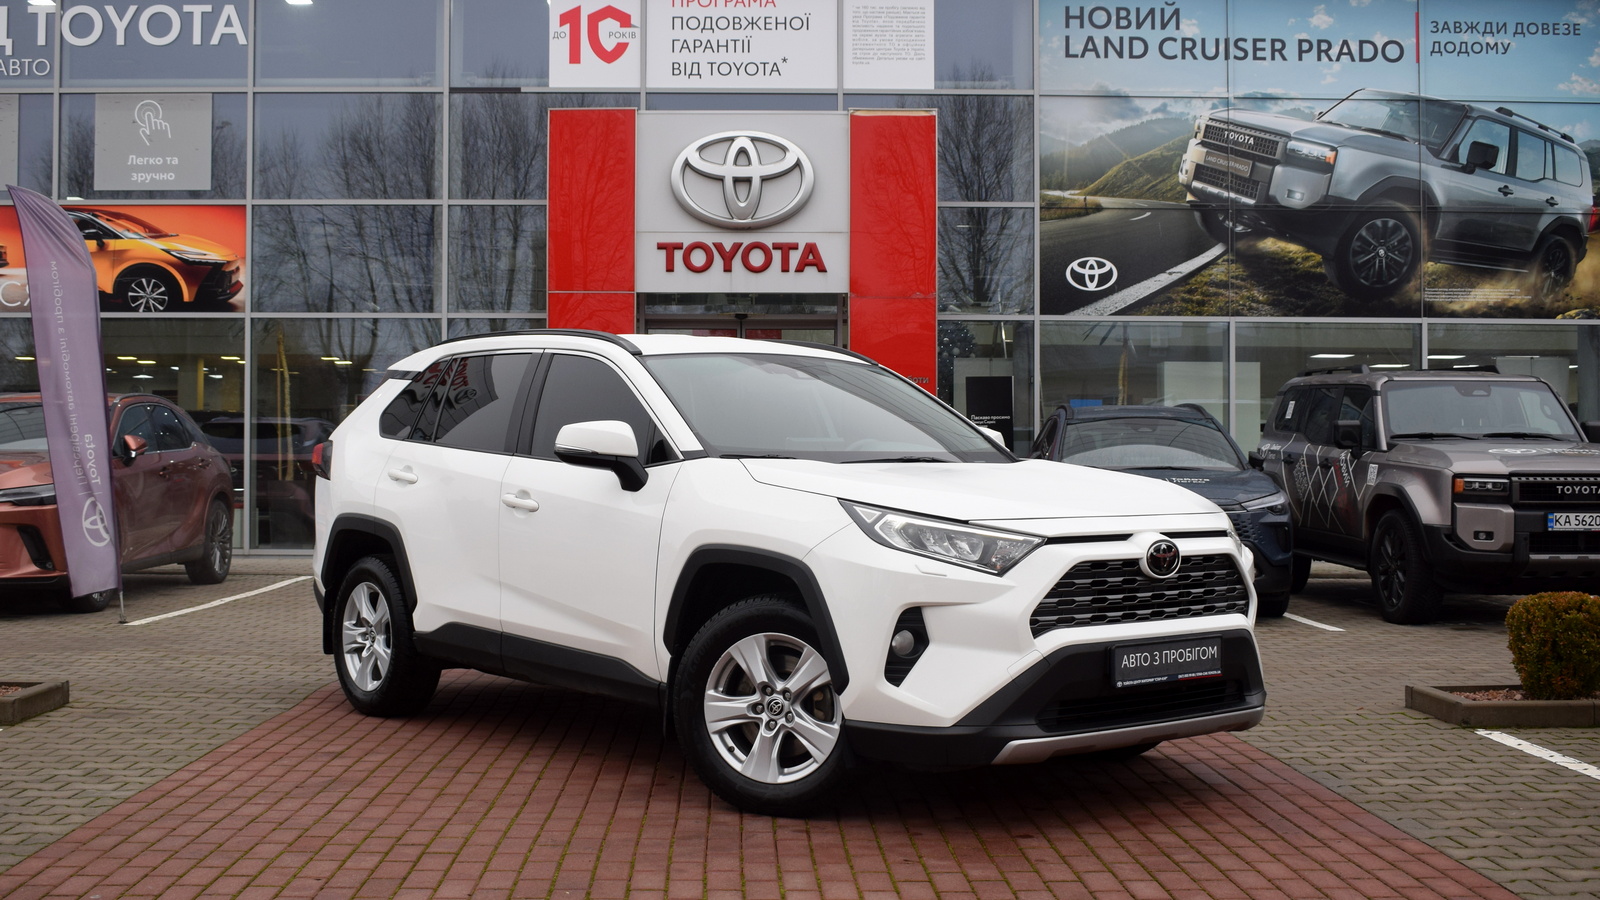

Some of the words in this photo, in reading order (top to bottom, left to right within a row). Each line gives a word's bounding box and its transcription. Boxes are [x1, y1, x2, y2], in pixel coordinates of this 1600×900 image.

[672, 12, 810, 34] ПОДОВЖЕНОЇ
[1064, 2, 1182, 31] НОВИЙ
[28, 4, 248, 47] TOYOTA
[1430, 20, 1507, 36] ЗАВЖДИ
[1512, 22, 1582, 37] ДОВЕЗЕ
[552, 31, 567, 40] ДО
[608, 31, 636, 39] РОКІВ
[672, 36, 752, 54] ГАРАНТІЇ
[1064, 35, 1149, 60] LAND
[1158, 36, 1288, 62] CRUISER
[1297, 38, 1405, 64] PRADO
[1430, 40, 1511, 57] ДОДОМУ
[672, 62, 702, 79] ВІД
[1224, 131, 1254, 145] TOYOTA
[128, 155, 163, 166] Легко
[166, 156, 178, 166] та
[131, 172, 175, 181] зручно
[656, 242, 828, 274] TOYOTA
[1554, 515, 1572, 526] KA
[1574, 515, 1600, 526] 5620
[1121, 652, 1150, 668] АВТО
[1153, 652, 1159, 665] З
[1162, 646, 1217, 664] ПРОБІГОМ
